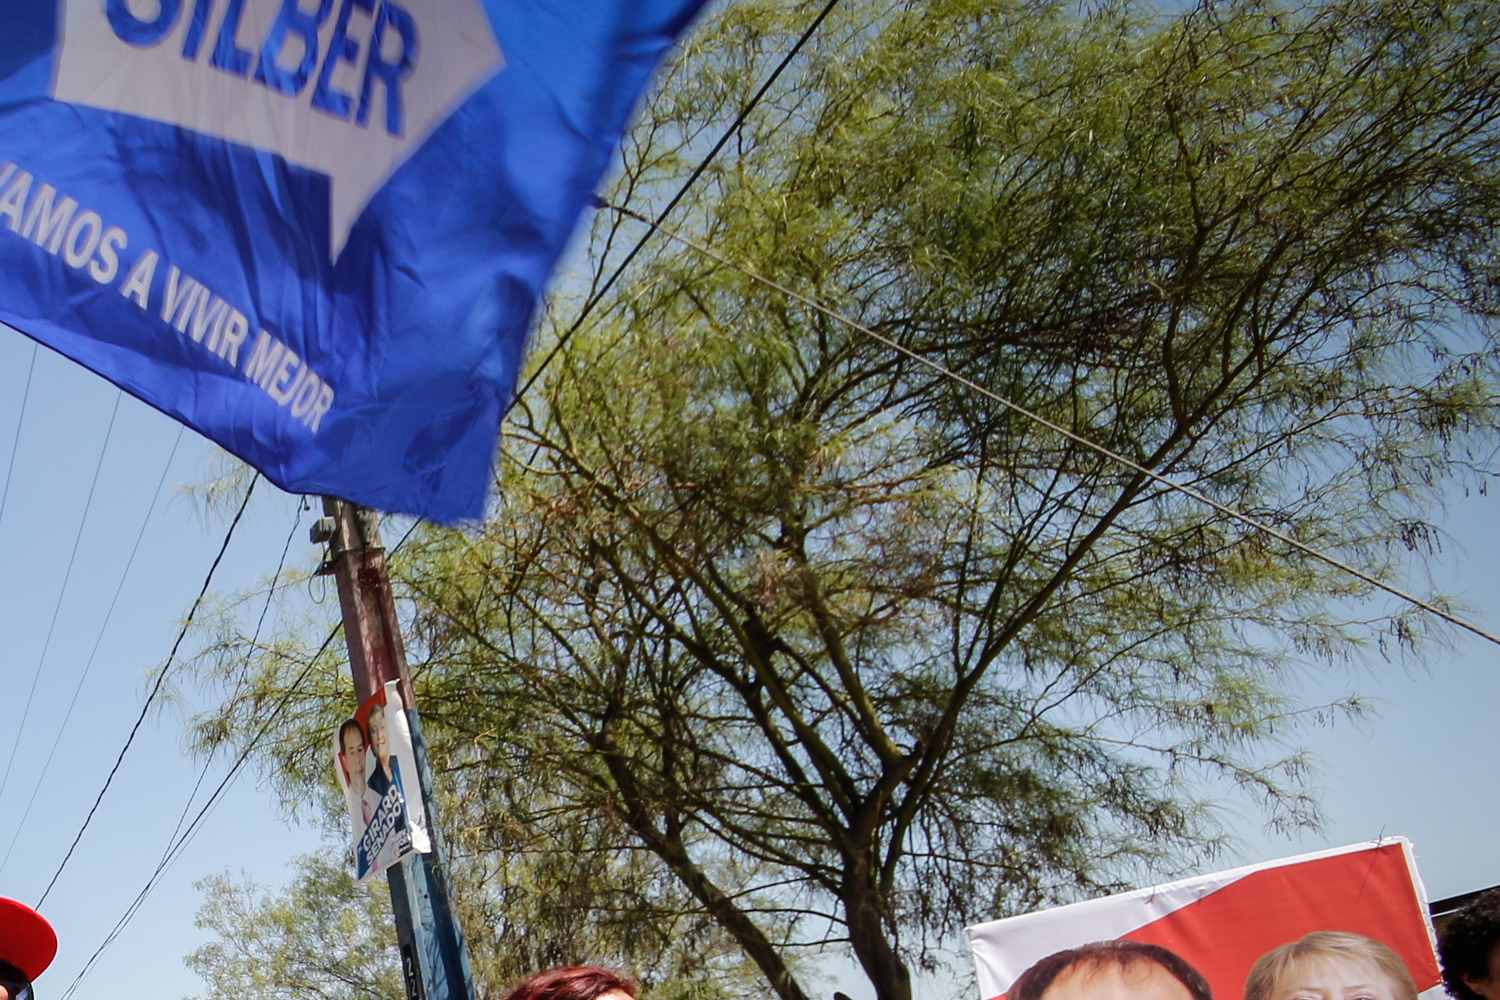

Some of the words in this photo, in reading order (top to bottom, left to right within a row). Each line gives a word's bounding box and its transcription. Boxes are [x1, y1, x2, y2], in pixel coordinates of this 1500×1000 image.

[119, 248, 160, 311] A
[161, 264, 249, 369] VIVIR
[243, 328, 335, 434] MEJOR
[363, 784, 400, 851] GIRARD
[366, 801, 402, 866] SENADO
